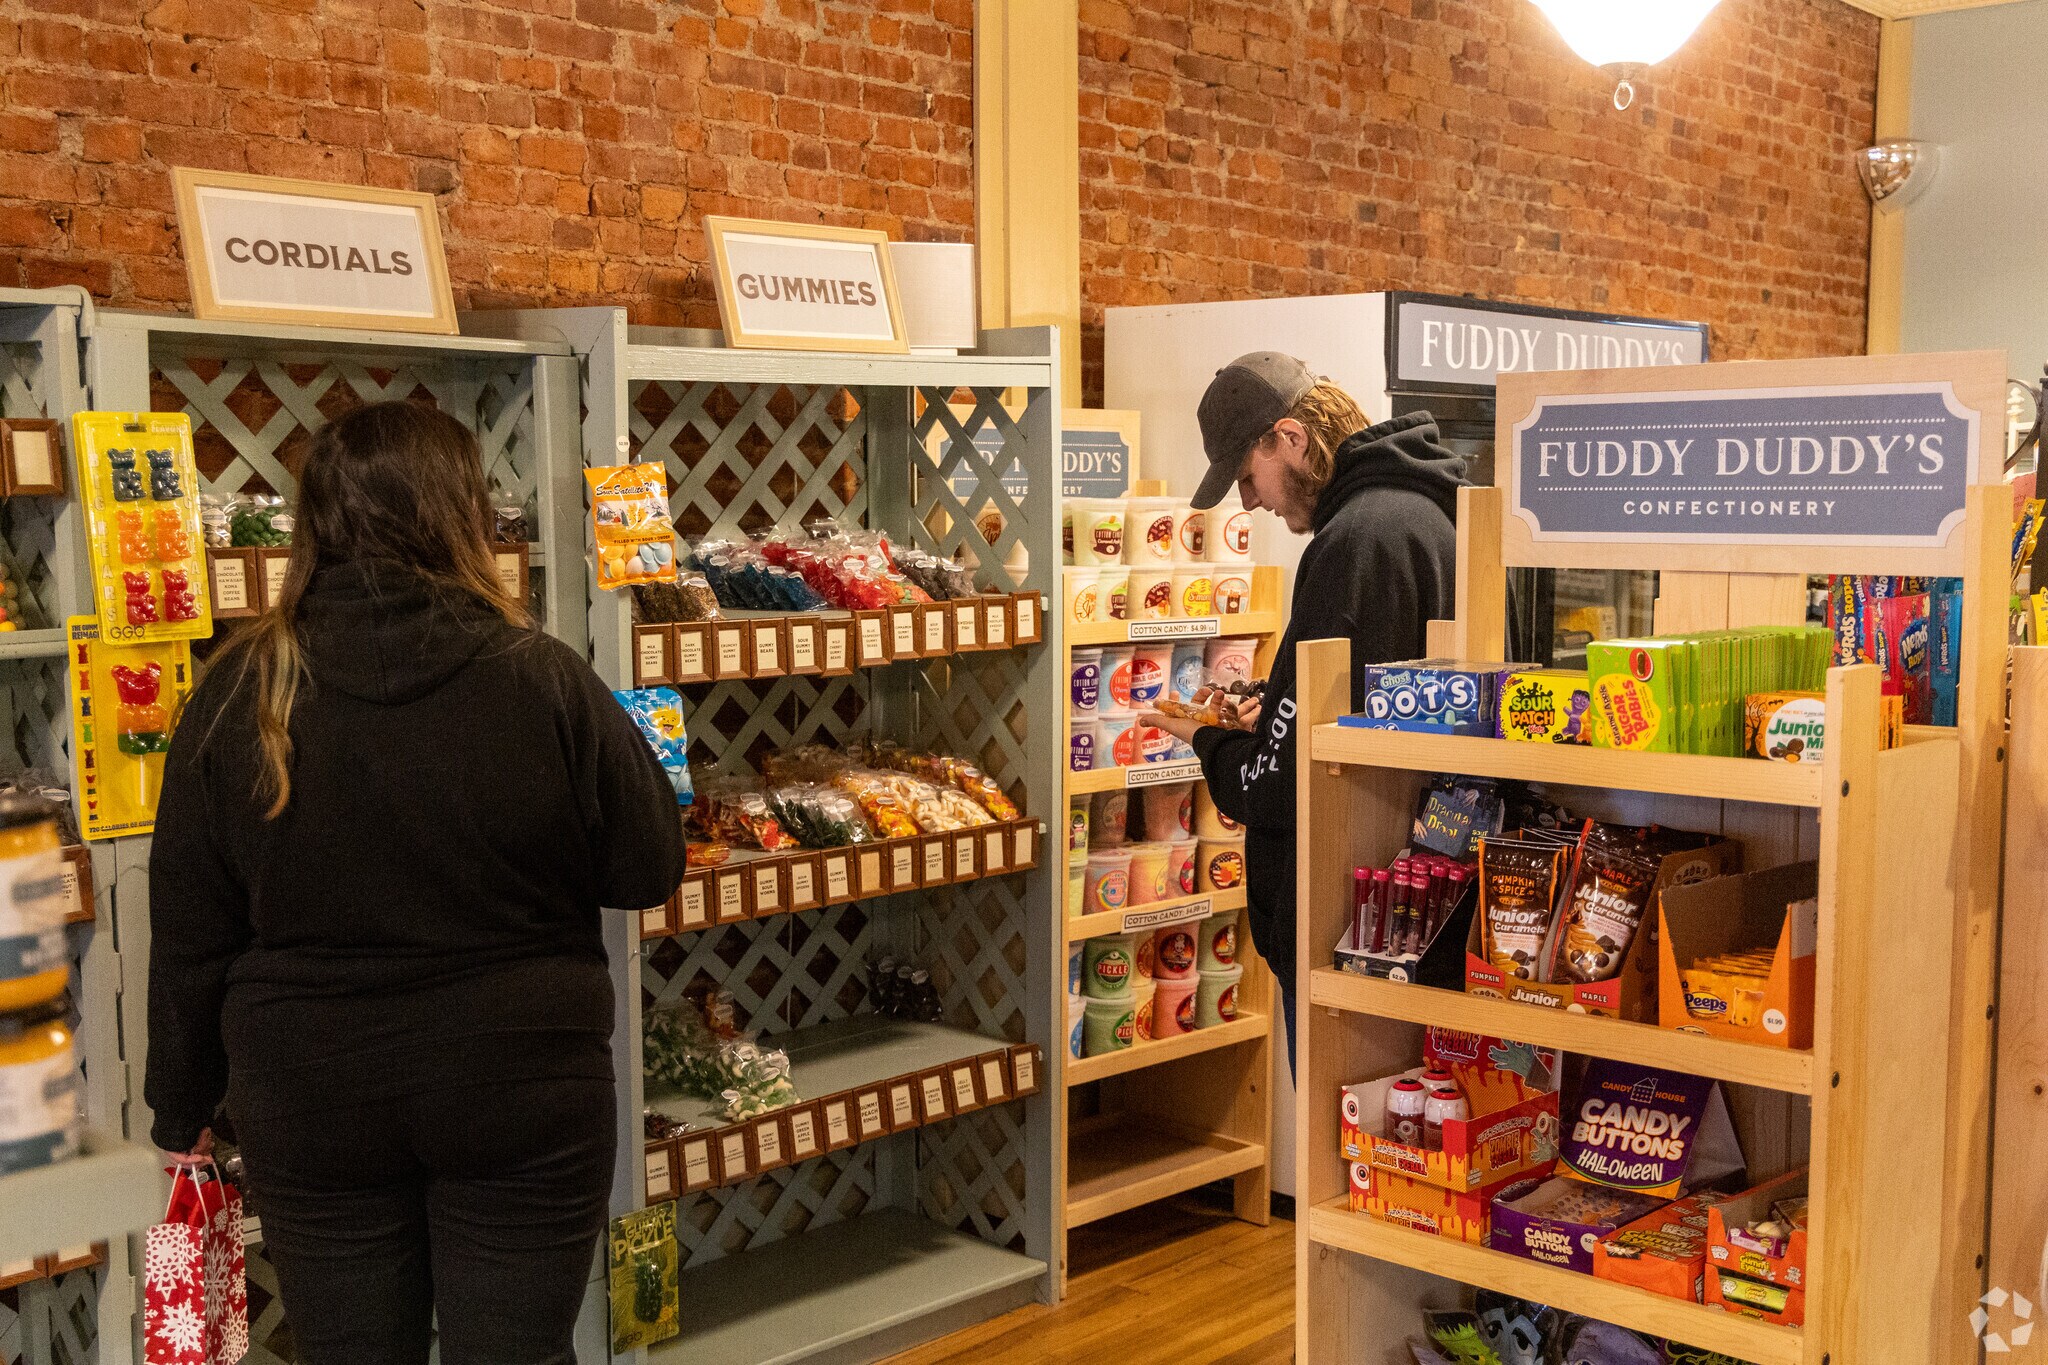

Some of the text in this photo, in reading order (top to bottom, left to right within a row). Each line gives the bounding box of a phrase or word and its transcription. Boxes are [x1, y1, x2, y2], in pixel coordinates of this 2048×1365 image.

[225, 237, 413, 276] CORDIALS
[737, 273, 877, 306] GUMMIES
[1421, 320, 1542, 372] FUDDY
[1062, 451, 1122, 474] DDY'S
[1538, 434, 1945, 477] FUDDY DUDDY'S
[614, 484, 644, 496] Satellite
[1623, 500, 1836, 516] CONFECTIONERY
[1842, 575, 1855, 615] Rope
[1133, 626, 1163, 635] COTTON
[1164, 625, 1189, 634] CANDY:
[1073, 678, 1089, 688] COTTON
[1147, 670, 1163, 681] GUM
[1381, 671, 1411, 689] Ghost
[1081, 689, 1097, 701] Grape
[1370, 679, 1469, 719] DOTS
[1511, 695, 1553, 712] SOUR
[1599, 683, 1622, 746] Caramel Apple
[1622, 679, 1649, 733] BABIES
[1510, 710, 1555, 727] PATCH
[1613, 694, 1639, 745] SUGAR
[1768, 718, 1824, 737] Junio
[1528, 724, 1546, 734] Kids
[1141, 738, 1164, 749] BUBBLE
[1073, 757, 1090, 768] Grape
[1130, 769, 1187, 781] COTTON CANDY:
[1428, 796, 1470, 826] Dracula
[1426, 814, 1458, 840] Drool
[1491, 874, 1535, 889] PUMPKIN
[1602, 868, 1632, 885] MAPLE
[1498, 884, 1525, 896] SPICE
[1575, 883, 1639, 915] Junior
[1127, 910, 1184, 925] COTTON CANDY:
[1489, 904, 1541, 924] Junior
[1584, 900, 1639, 928] Caramels
[1494, 921, 1546, 935] Caramels
[1097, 963, 1128, 975] PICKLE
[1391, 973, 1406, 982] $2.99
[1470, 971, 1500, 983] PUMPKIN
[1511, 987, 1560, 1008] Junior
[1581, 991, 1608, 1003] MAPLE
[1684, 992, 1728, 1012] Peeps
[1767, 1017, 1783, 1026] $1.99
[1434, 1037, 1479, 1058] EYEBALL
[1601, 1081, 1686, 1103] CANDY HOUSE
[860, 1101, 878, 1110] GUMMY
[861, 1108, 878, 1118] PEACH
[863, 1115, 878, 1123] RINGS
[1580, 1098, 1692, 1140] CANDY
[796, 1126, 810, 1134] GREEN
[1489, 1129, 1520, 1153] ZOMBIE
[1572, 1121, 1686, 1162] BUTTONS
[1372, 1149, 1398, 1167] ZOMBIE
[1398, 1157, 1428, 1177] EYEBALL
[647, 1171, 669, 1180] CHERRIES
[614, 1218, 674, 1262] PICKLE
[1524, 1227, 1571, 1246] CANDY
[1525, 1237, 1573, 1256] BUTTONS
